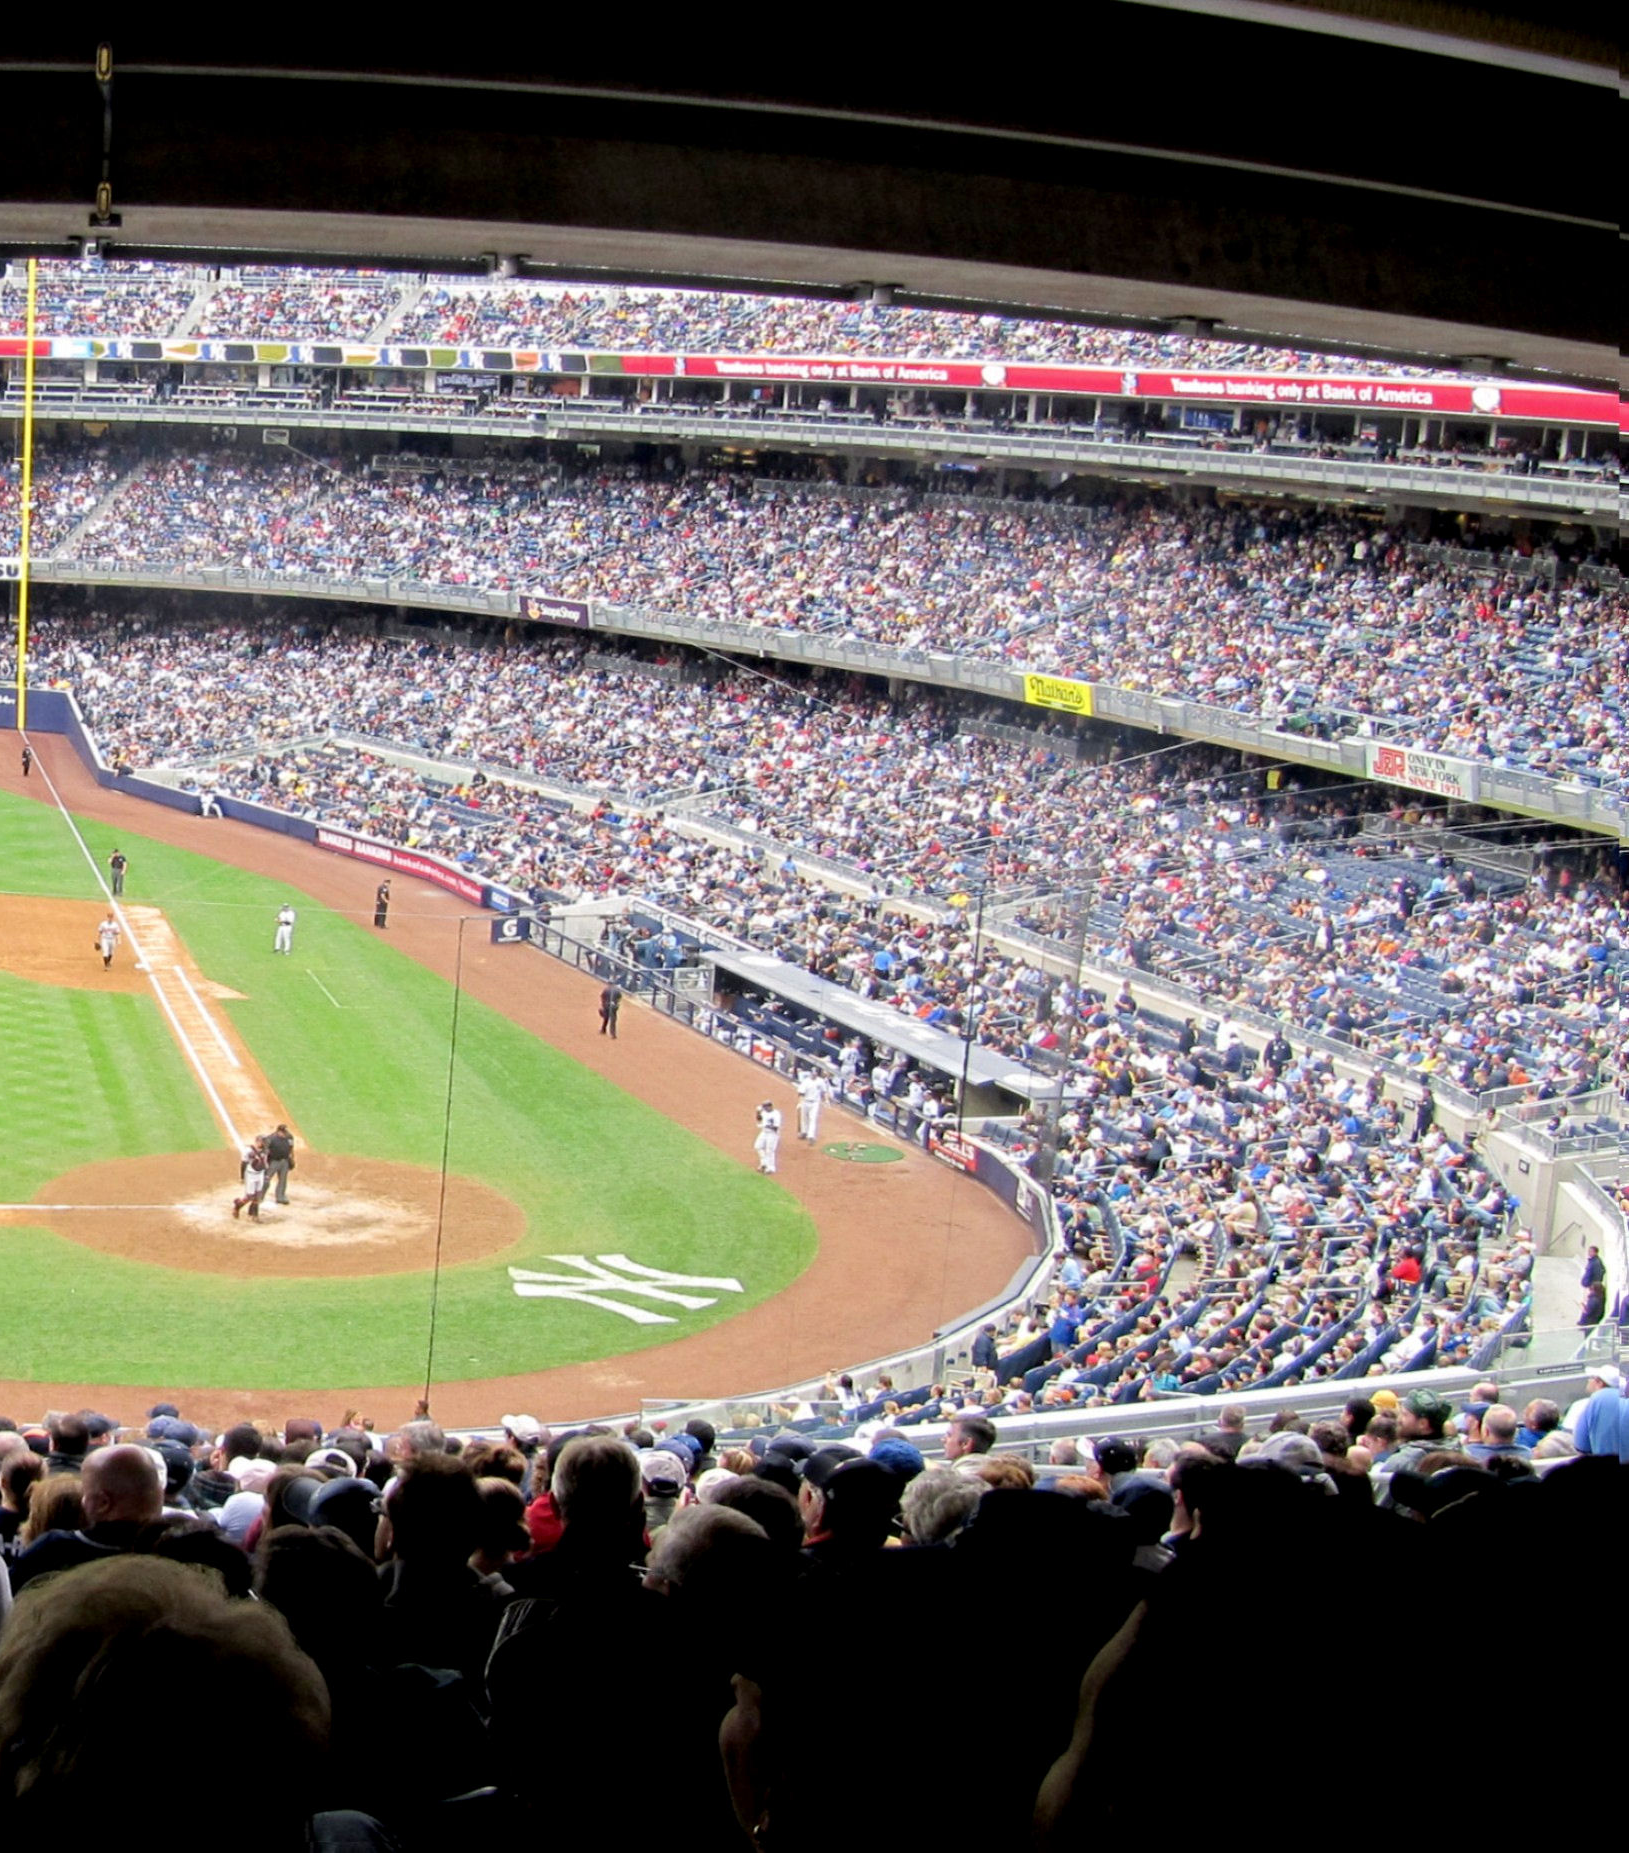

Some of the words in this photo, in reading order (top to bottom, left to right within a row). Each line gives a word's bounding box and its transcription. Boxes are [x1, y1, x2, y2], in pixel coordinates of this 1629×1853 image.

[766, 361, 807, 380] banking
[811, 364, 834, 381] only
[837, 365, 848, 378] at
[851, 364, 877, 379] Bank
[880, 364, 893, 379] of
[895, 366, 948, 382] America
[1226, 380, 1275, 401] banking
[1278, 385, 1303, 403] only
[1306, 386, 1319, 400] at
[1322, 385, 1355, 402] Bank
[1358, 386, 1373, 402] of
[1375, 389, 1433, 405] America
[1029, 676, 1083, 704] Nathan's
[1373, 747, 1406, 779] J&R
[1407, 753, 1432, 767] ONLY
[1409, 765, 1429, 779] NEW
[1432, 770, 1460, 785] YORK
[1409, 776, 1436, 791] SINCE
